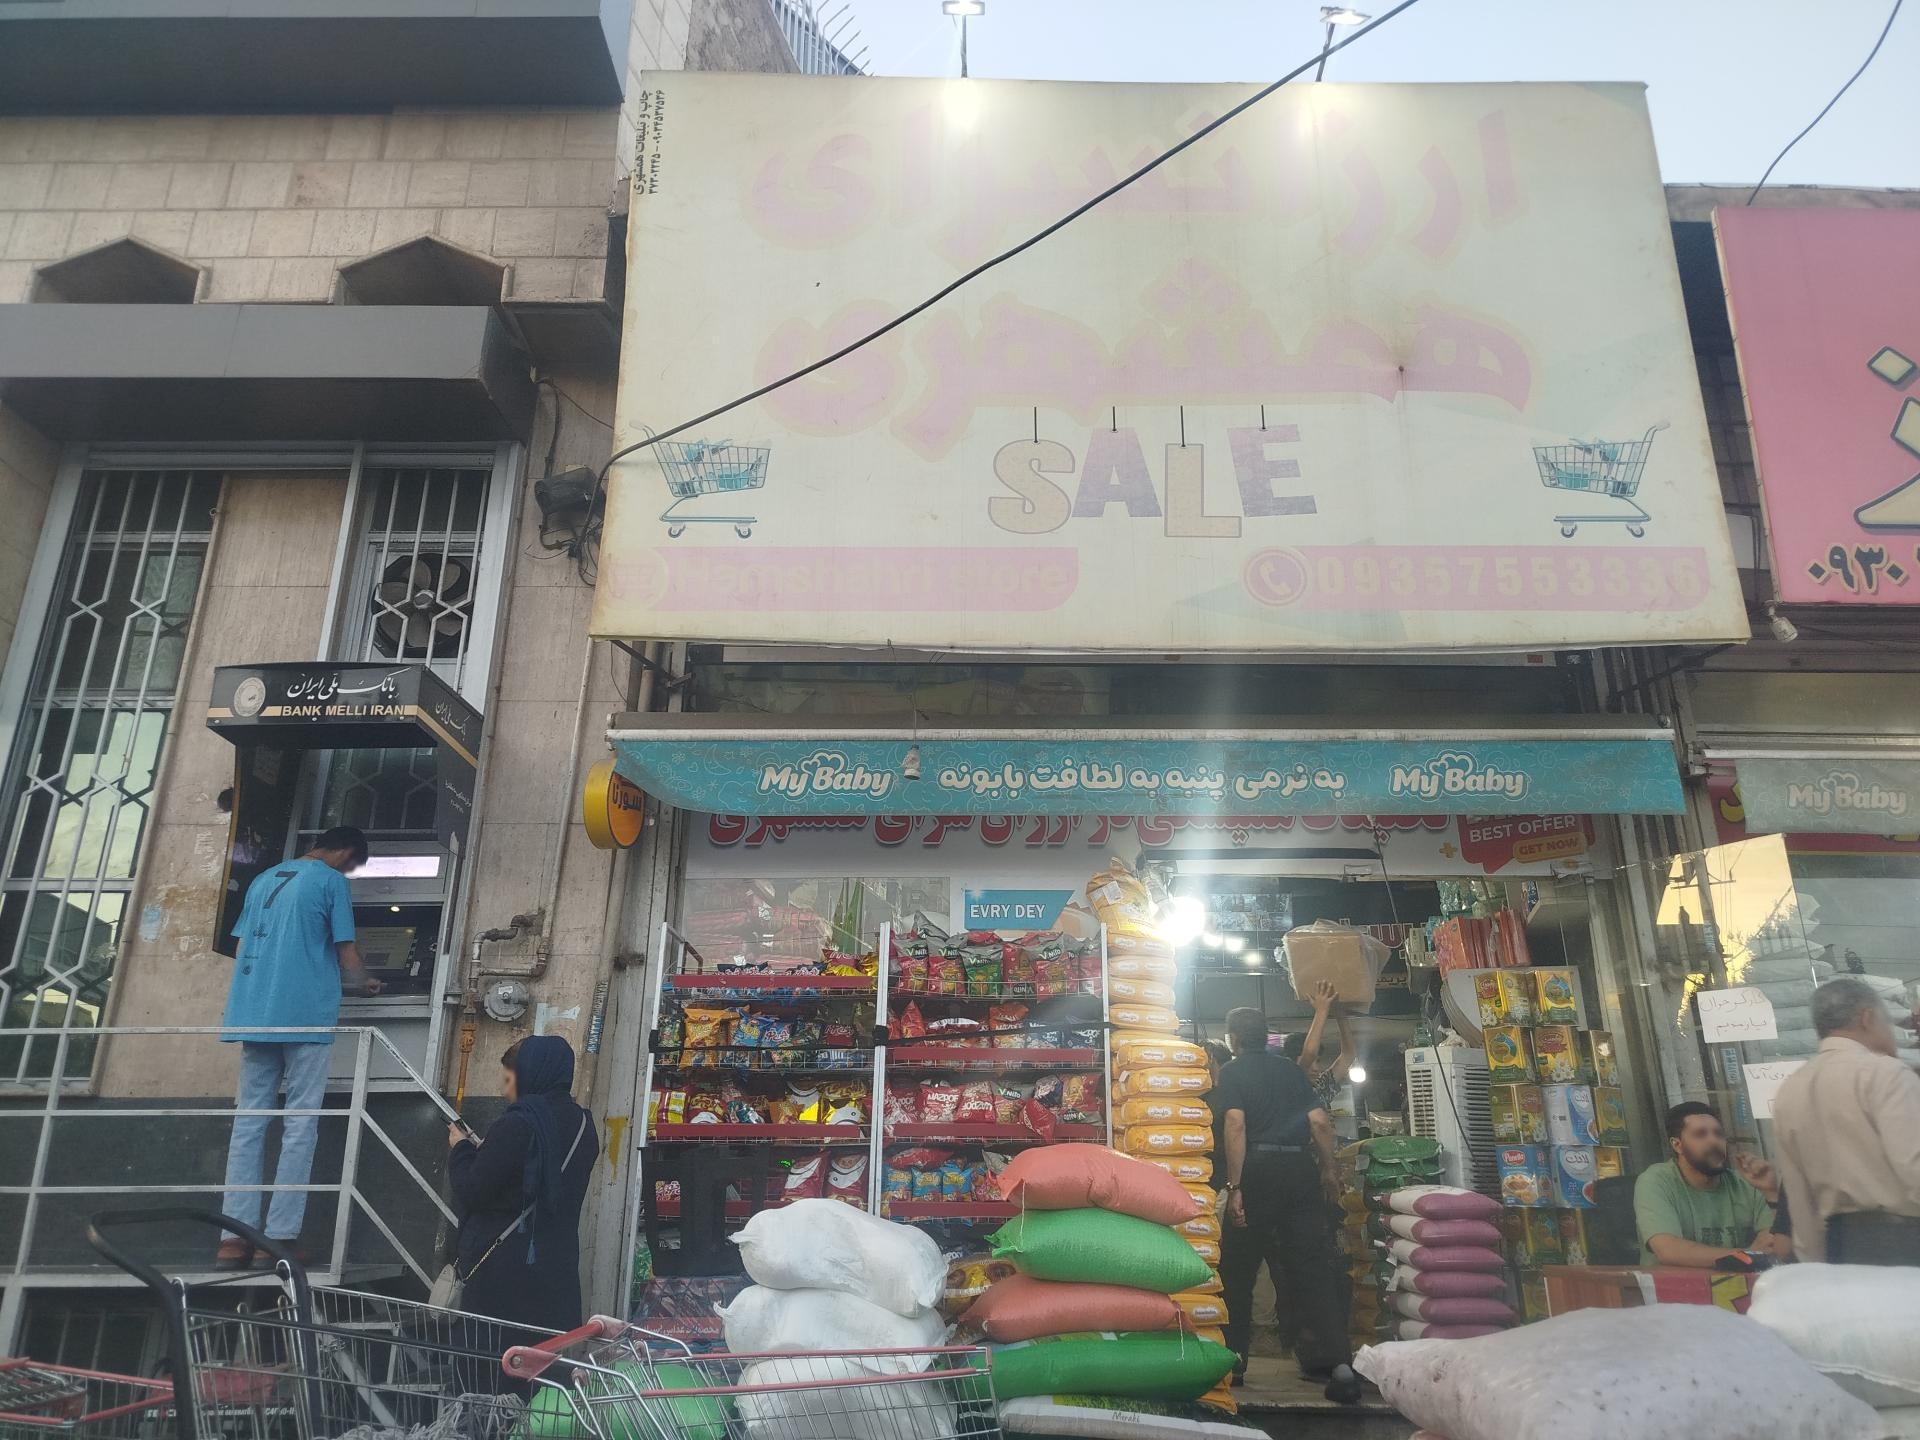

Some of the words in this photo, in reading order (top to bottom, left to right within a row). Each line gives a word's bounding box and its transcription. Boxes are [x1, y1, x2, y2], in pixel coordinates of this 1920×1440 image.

[988, 424, 1317, 537] SALE
[679, 557, 932, 595] Hamshahri
[948, 559, 1066, 595] store
[287, 672, 324, 700] ایران
[318, 672, 339, 700] ملی
[337, 666, 411, 700] بانک
[282, 705, 321, 716] BANK
[325, 705, 367, 716] MELLI
[370, 704, 404, 716] IRAN
[939, 757, 1025, 801] بابونه
[1029, 761, 1124, 790] لطافت
[1130, 768, 1160, 799] به
[1165, 765, 1225, 800] پنبه
[1235, 762, 1308, 799] نرمی
[1312, 768, 1347, 799] به
[1470, 823, 1513, 843] BEST
[1518, 815, 1576, 836] OFFER
[1519, 843, 1543, 856] GET
[1547, 837, 1579, 852] NOW
[263, 870, 298, 909] 7
[970, 903, 1010, 920] EVRY
[1015, 903, 1046, 920] DEY
